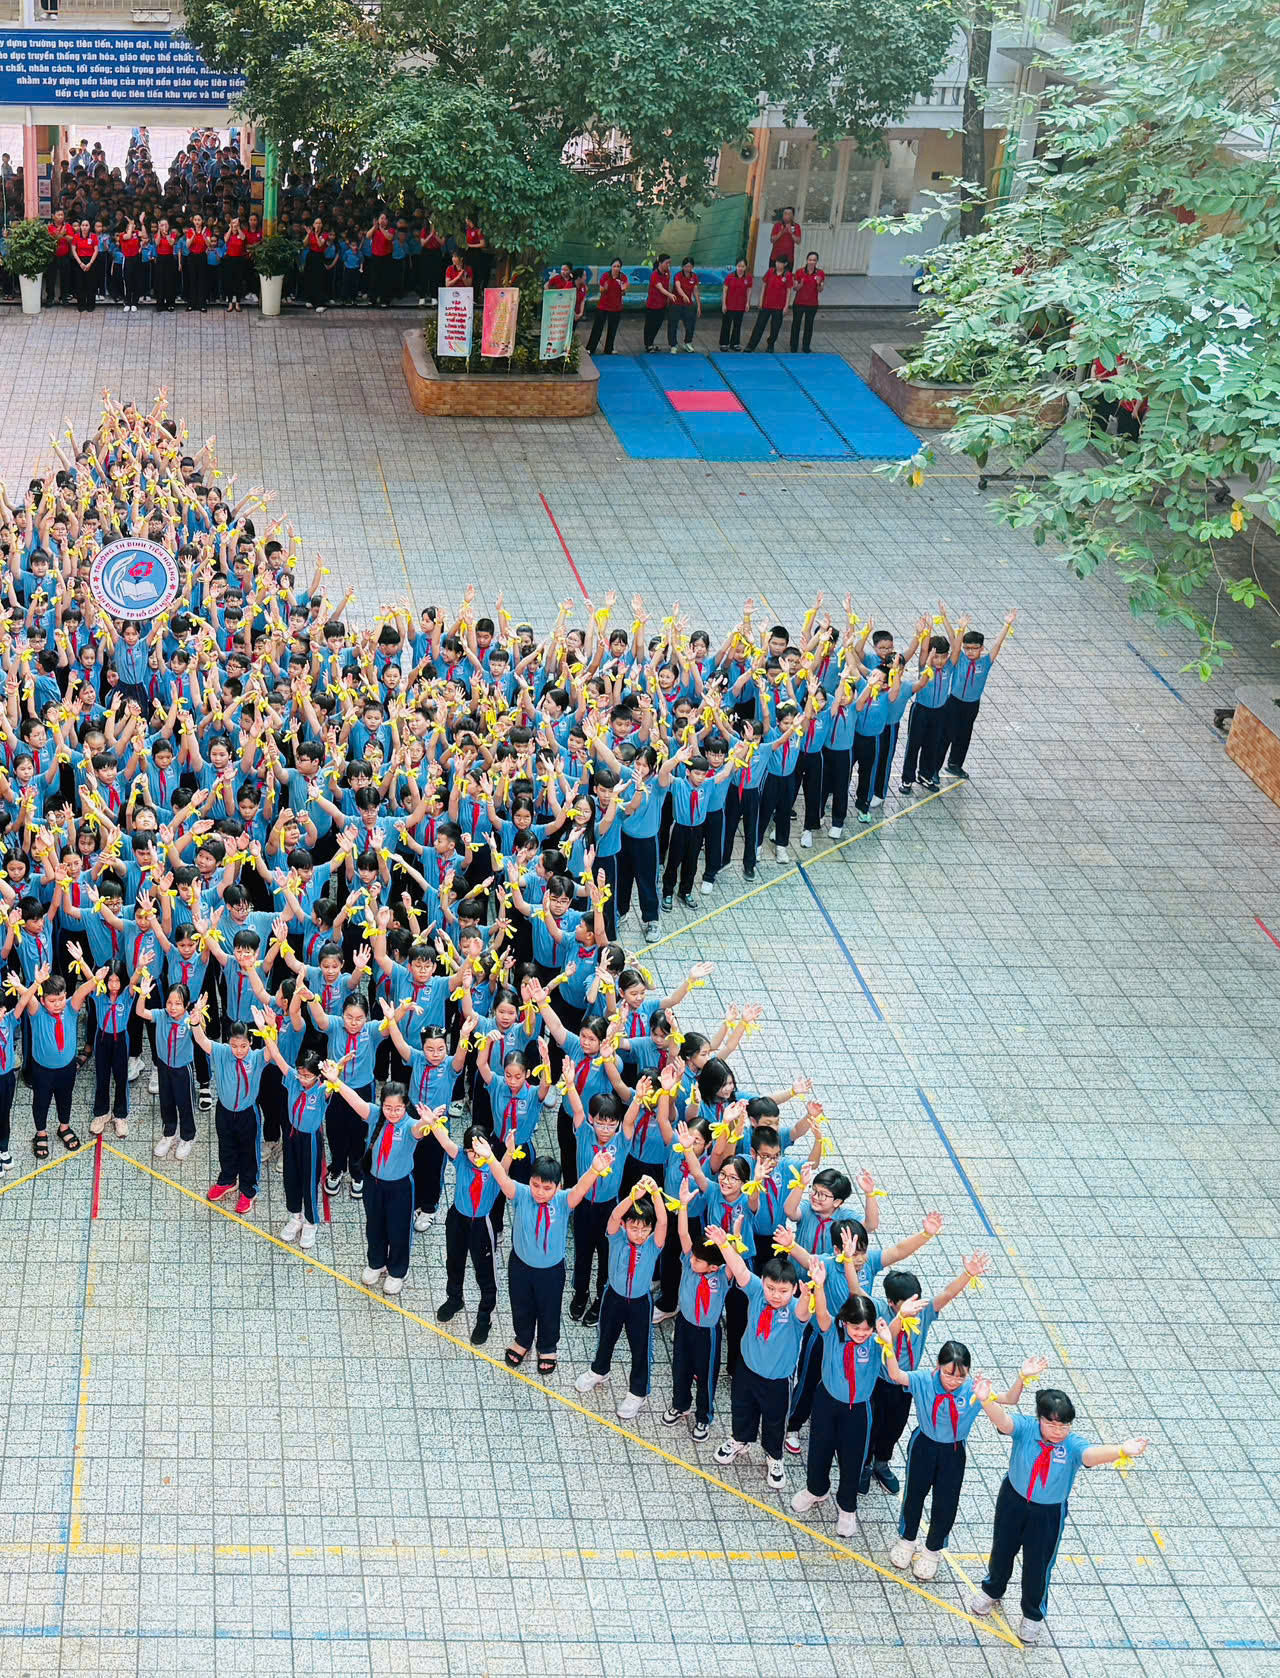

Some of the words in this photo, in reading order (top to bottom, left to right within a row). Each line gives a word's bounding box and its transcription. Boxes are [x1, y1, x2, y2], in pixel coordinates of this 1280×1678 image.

[7, 39, 27, 49] dựng
[29, 39, 56, 49] trường
[58, 39, 74, 49] học
[76, 39, 93, 48] tiên
[115, 40, 134, 49] hiện
[154, 40, 167, 50] hội
[10, 52, 26, 61] dục
[27, 51, 55, 61] truyền
[56, 51, 80, 61] thống
[82, 52, 97, 60] văn
[119, 53, 138, 62] giáo
[140, 53, 156, 62] dục
[158, 52, 171, 61] thể
[28, 64, 50, 72] nhân
[76, 63, 88, 73] lối
[115, 65, 130, 74] chú
[132, 66, 154, 75] trọng
[156, 65, 174, 75] phát
[16, 75, 40, 85] nhằm
[42, 77, 57, 86] xây
[59, 77, 80, 86] dựng
[81, 76, 98, 85] nền
[99, 76, 118, 86] tảng
[120, 76, 136, 86] của
[137, 78, 154, 87] một
[155, 77, 171, 86] nền
[173, 78, 191, 87] giáo
[193, 78, 209, 88] dục
[211, 78, 227, 87] tiên
[55, 88, 72, 98] tiếp
[73, 89, 89, 98] cận
[91, 90, 109, 98] giáo
[111, 90, 127, 99] dục
[129, 90, 145, 98] tiên
[146, 89, 163, 98] tiến
[165, 90, 181, 98] khu
[182, 91, 197, 100] vực
[199, 90, 210, 98] và
[211, 89, 226, 98] thế
